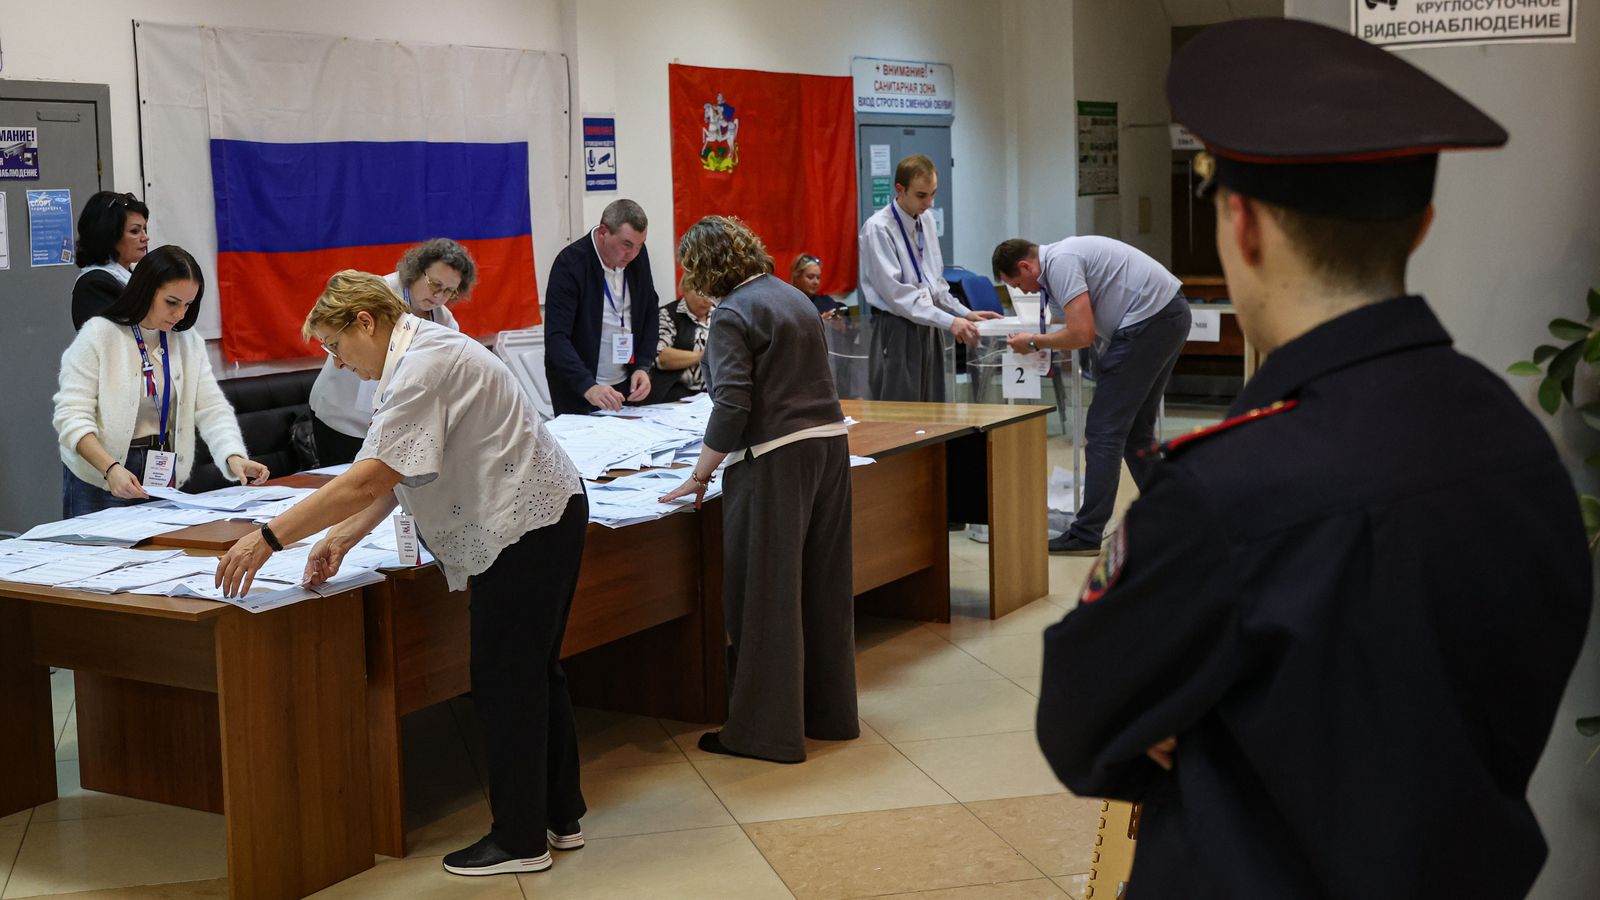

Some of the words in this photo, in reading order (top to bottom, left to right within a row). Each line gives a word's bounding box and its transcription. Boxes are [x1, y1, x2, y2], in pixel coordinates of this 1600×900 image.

[1416, 0, 1561, 14] КРУГЛОСУТОЧНОЕ
[1364, 13, 1561, 39] ВИДЕОНАБЛЮДЕНИЕ
[874, 80, 917, 92] САНИТАРНАЯ
[919, 83, 936, 94] ЗОНА
[858, 96, 875, 107] ВХОД
[876, 97, 898, 108] СТРОГО
[906, 98, 933, 109] СМЕННОЙ
[1015, 367, 1025, 383] 2
